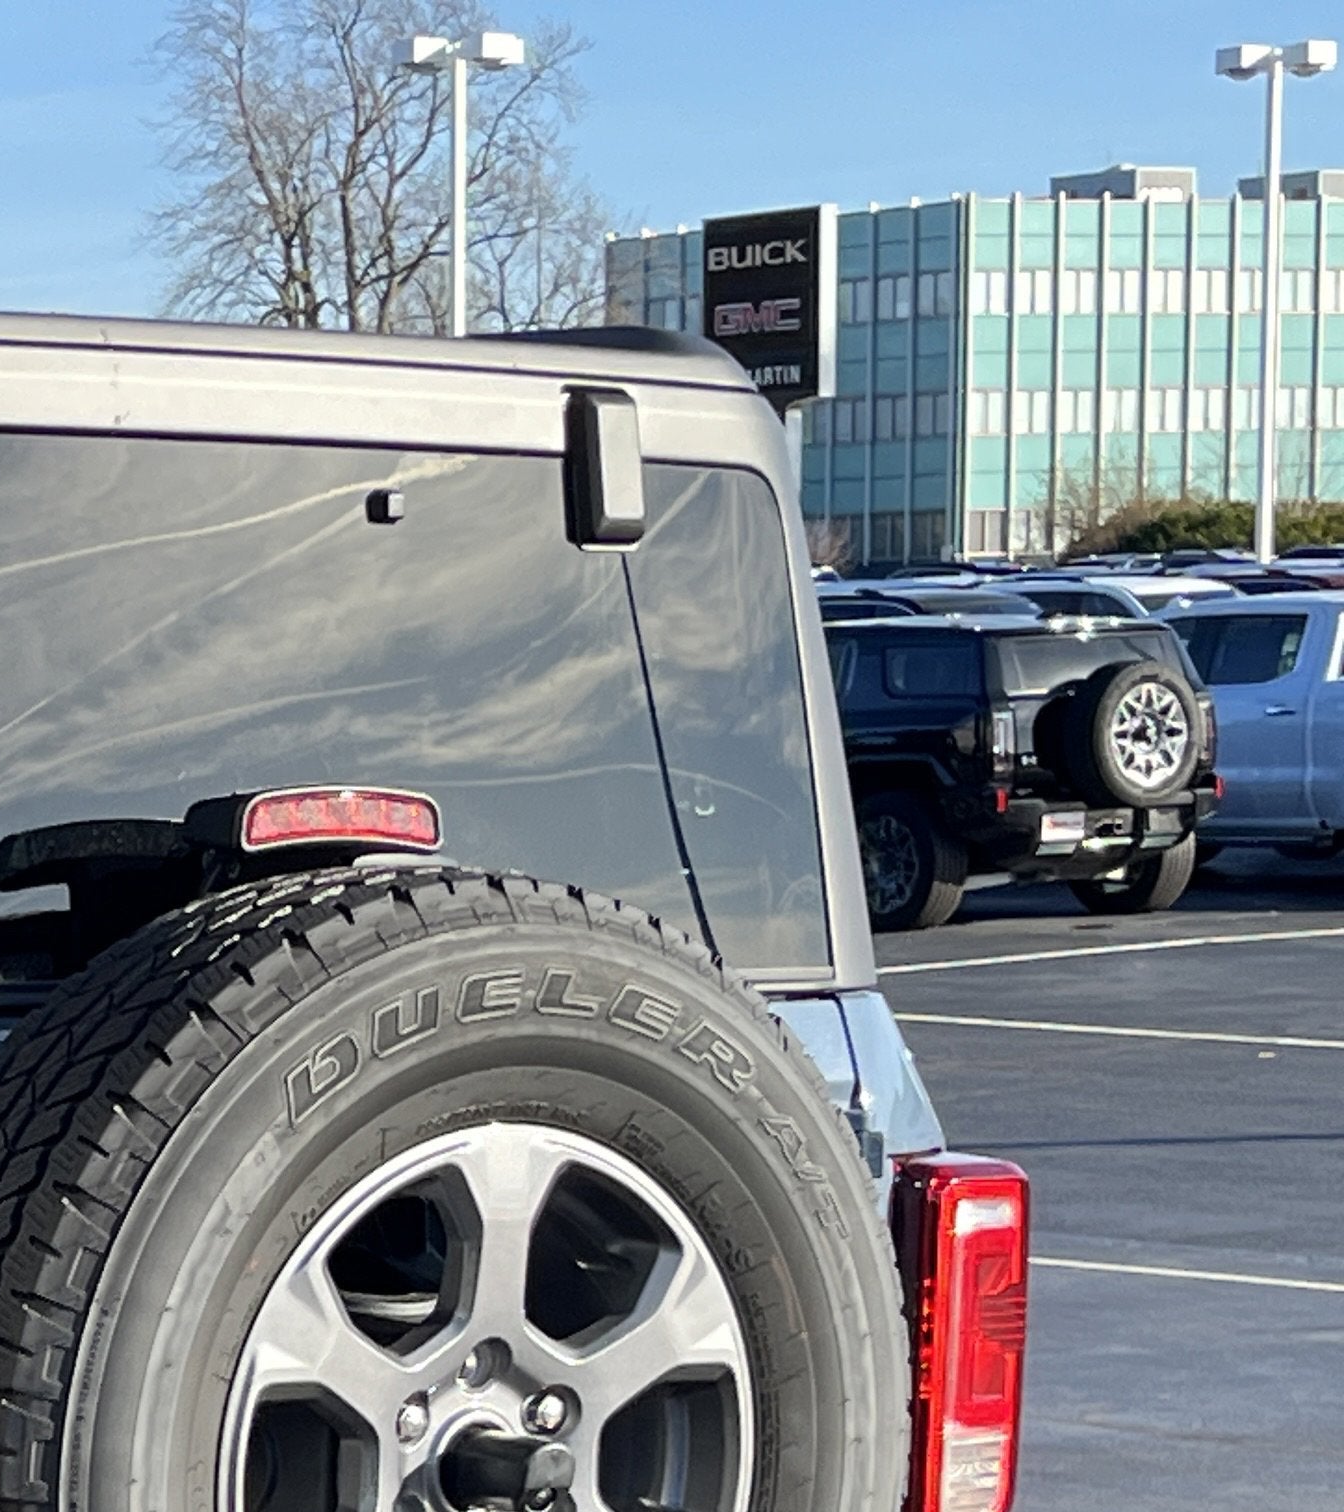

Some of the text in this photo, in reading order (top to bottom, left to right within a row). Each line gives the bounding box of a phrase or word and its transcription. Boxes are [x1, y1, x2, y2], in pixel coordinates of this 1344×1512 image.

[707, 238, 808, 272] BUICK
[714, 298, 801, 336] GMC
[283, 966, 758, 1128] DUELER
